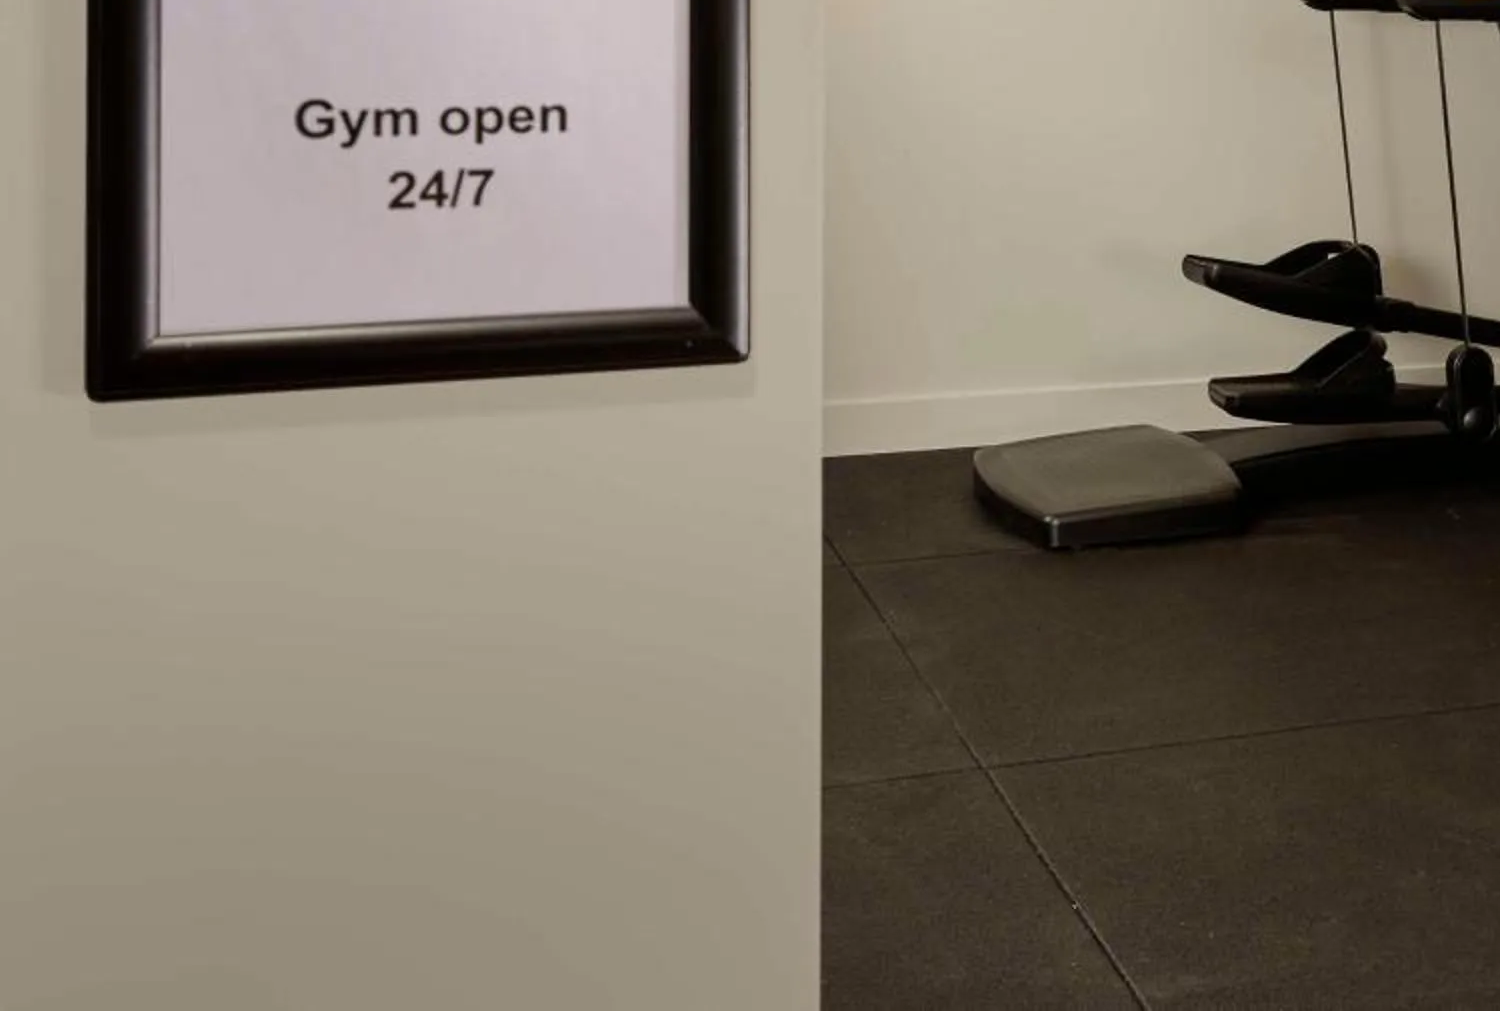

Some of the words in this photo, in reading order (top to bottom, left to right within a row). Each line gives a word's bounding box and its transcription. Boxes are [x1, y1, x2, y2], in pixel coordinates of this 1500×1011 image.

[294, 98, 418, 149] Gym
[439, 104, 568, 145] open
[387, 168, 495, 210] 24/7
